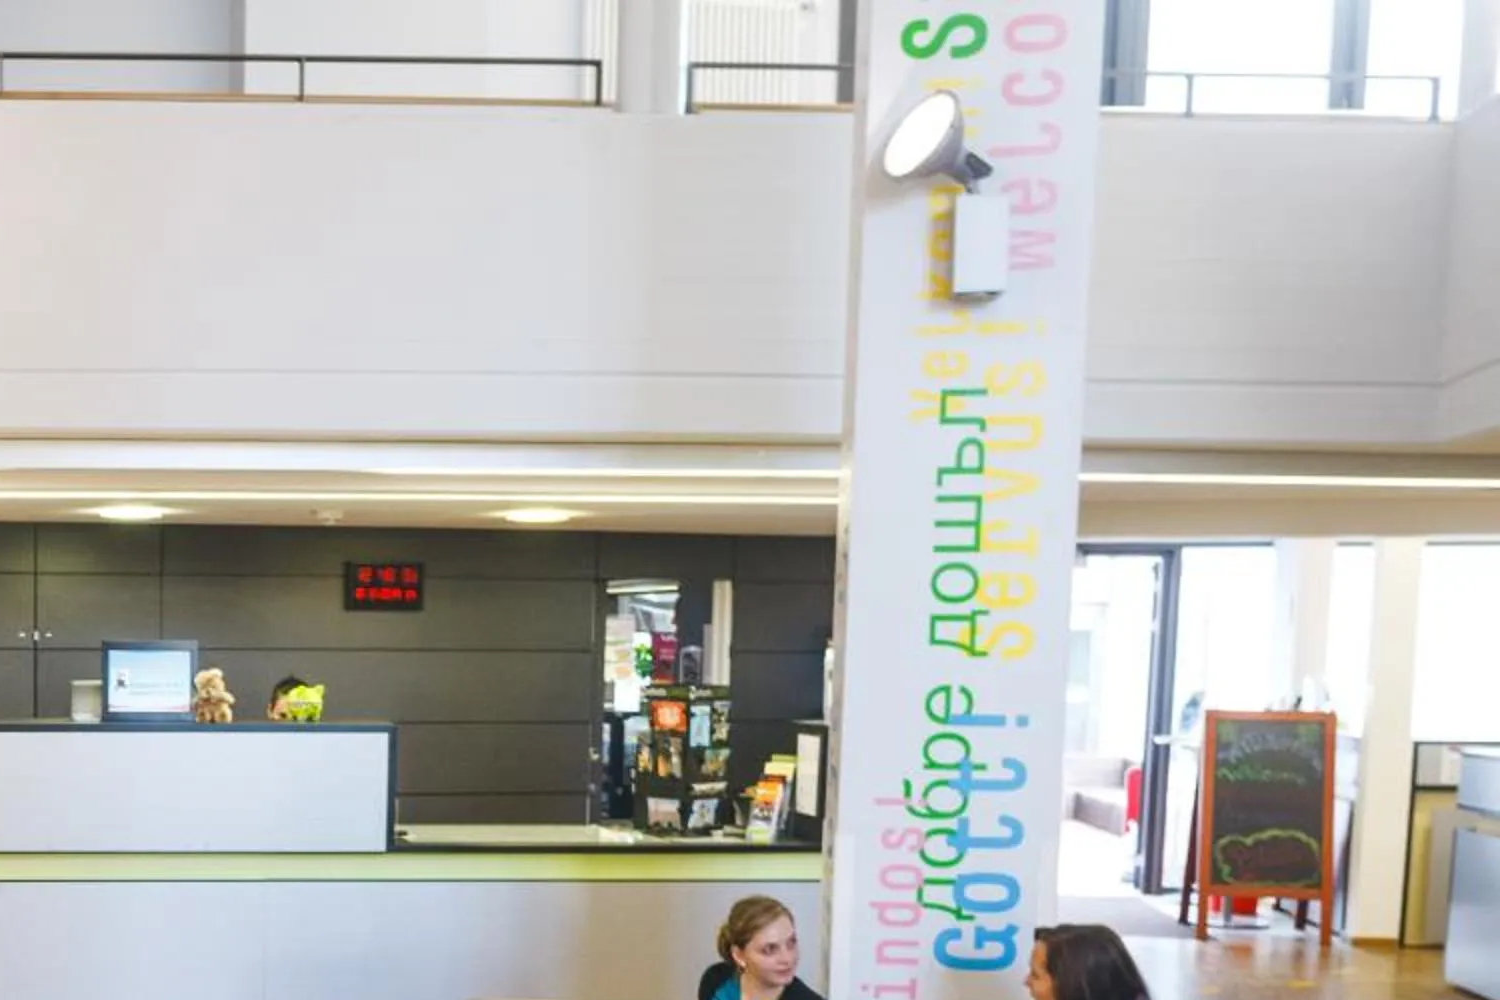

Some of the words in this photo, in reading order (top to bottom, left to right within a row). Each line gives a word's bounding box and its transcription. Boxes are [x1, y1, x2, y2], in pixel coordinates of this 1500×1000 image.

[988, 4, 1069, 272] welco
[930, 388, 988, 657] дошъл
[957, 318, 1046, 662] Servus!
[933, 713, 1030, 973] Gott!
